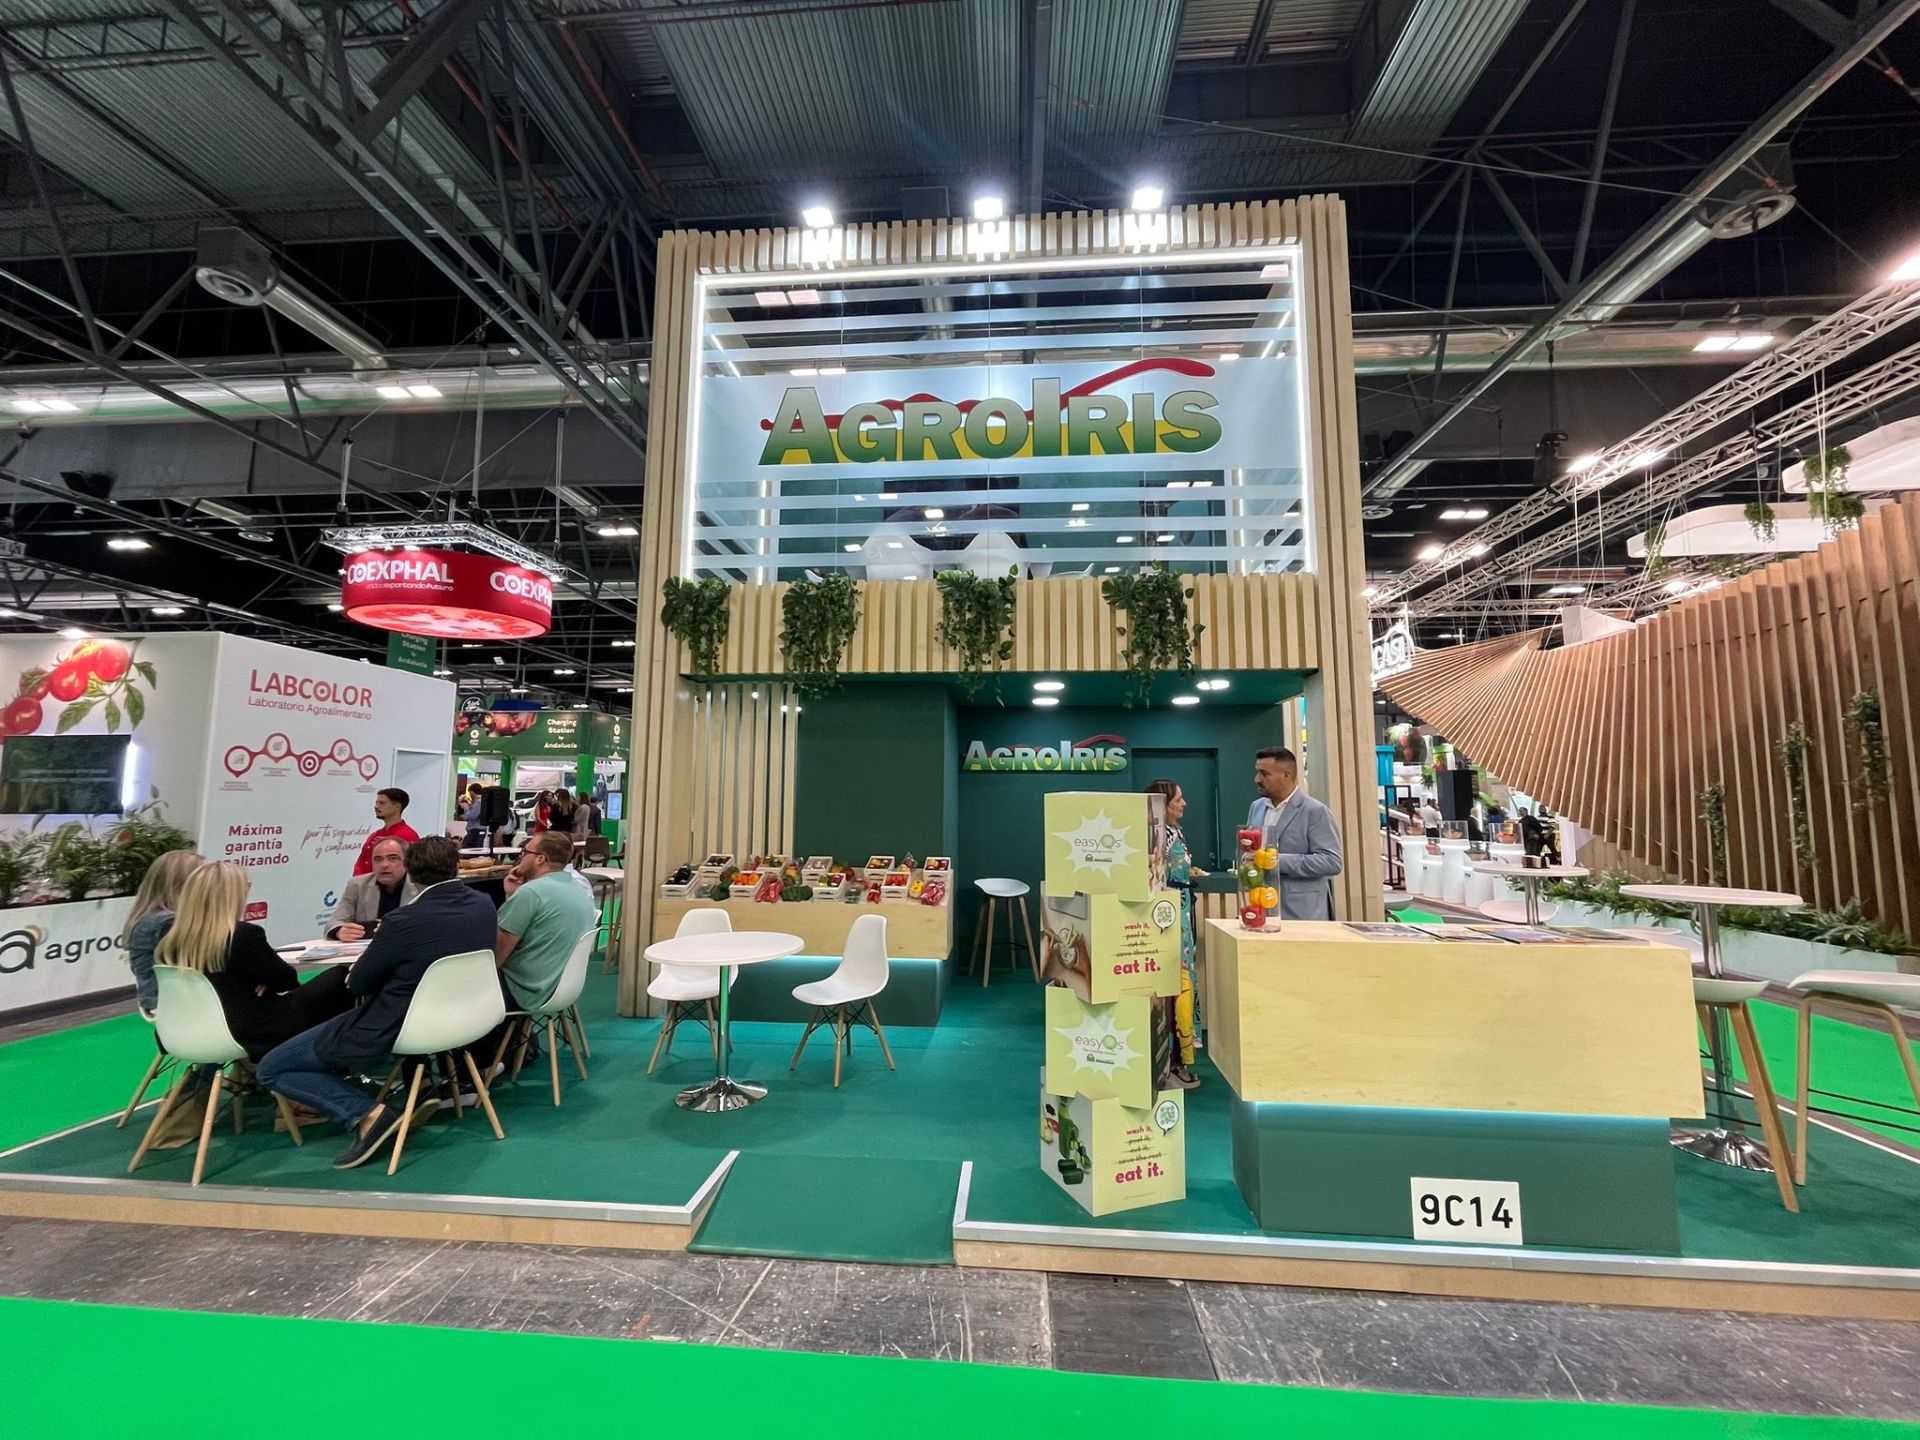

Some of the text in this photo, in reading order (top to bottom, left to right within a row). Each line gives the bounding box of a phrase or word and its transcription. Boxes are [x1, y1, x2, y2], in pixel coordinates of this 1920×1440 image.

[347, 560, 454, 585] COEXPHAL
[250, 669, 372, 708] LABCOLOR
[248, 697, 372, 720] Laboratorio Agroalimentario
[547, 719, 577, 727] Charging
[228, 824, 283, 837] Máxima
[225, 838, 283, 855] garantía
[216, 853, 289, 867] alizando
[1124, 922, 1142, 930] wash
[1113, 957, 1161, 975] eat it.
[1126, 1125, 1144, 1135] wash
[1115, 1161, 1164, 1184] eat it.
[1420, 1193, 1513, 1229] 9C14
